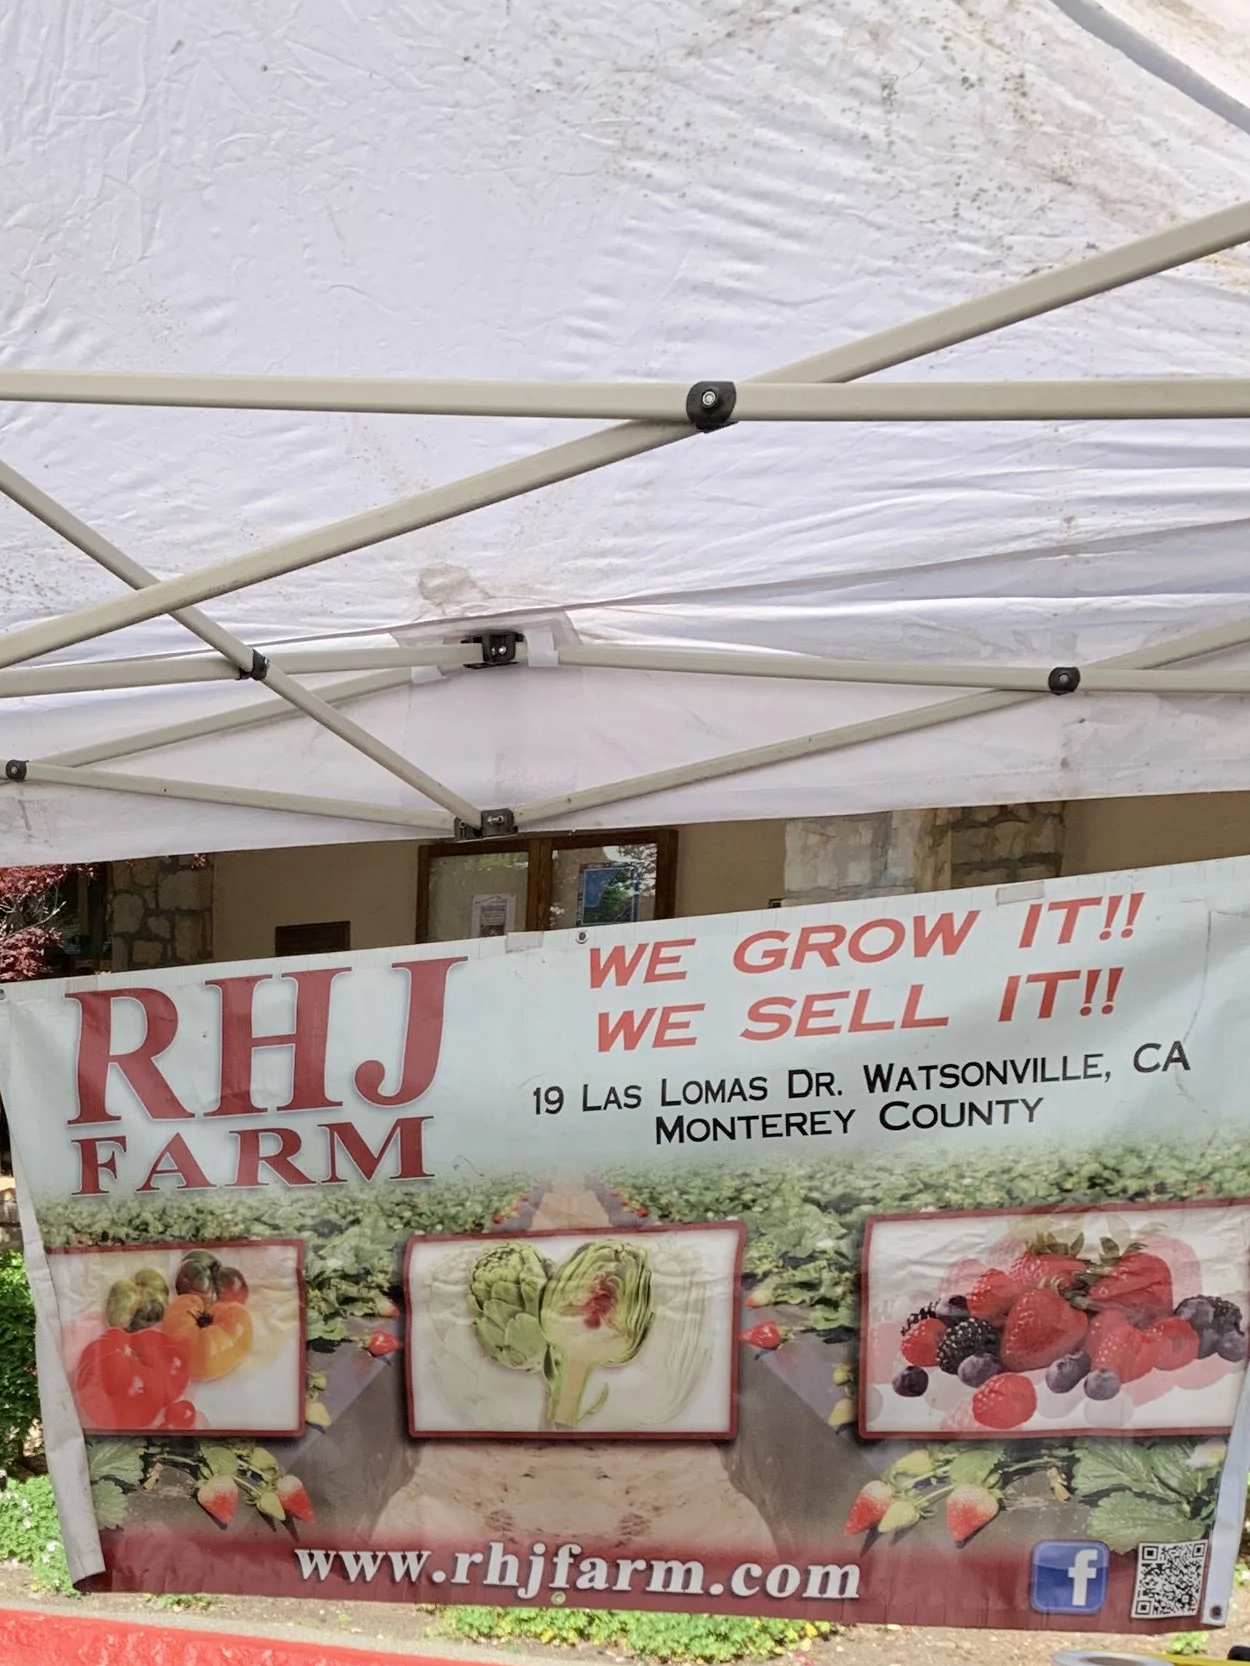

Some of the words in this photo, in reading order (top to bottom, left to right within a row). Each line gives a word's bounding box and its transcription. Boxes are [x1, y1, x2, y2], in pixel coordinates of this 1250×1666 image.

[588, 938, 695, 988] WE
[732, 909, 981, 975] GROW
[1017, 892, 1146, 949] IT!!
[64, 955, 469, 1127] RHJ
[597, 1002, 705, 1053] WE
[739, 983, 949, 1041] SELL
[996, 966, 1124, 1022] IT!!
[531, 1086, 565, 1116] 19
[1133, 1040, 1191, 1075] CA
[69, 1115, 436, 1198] FARM
[293, 1541, 862, 1600] www.rhjfarm.com
